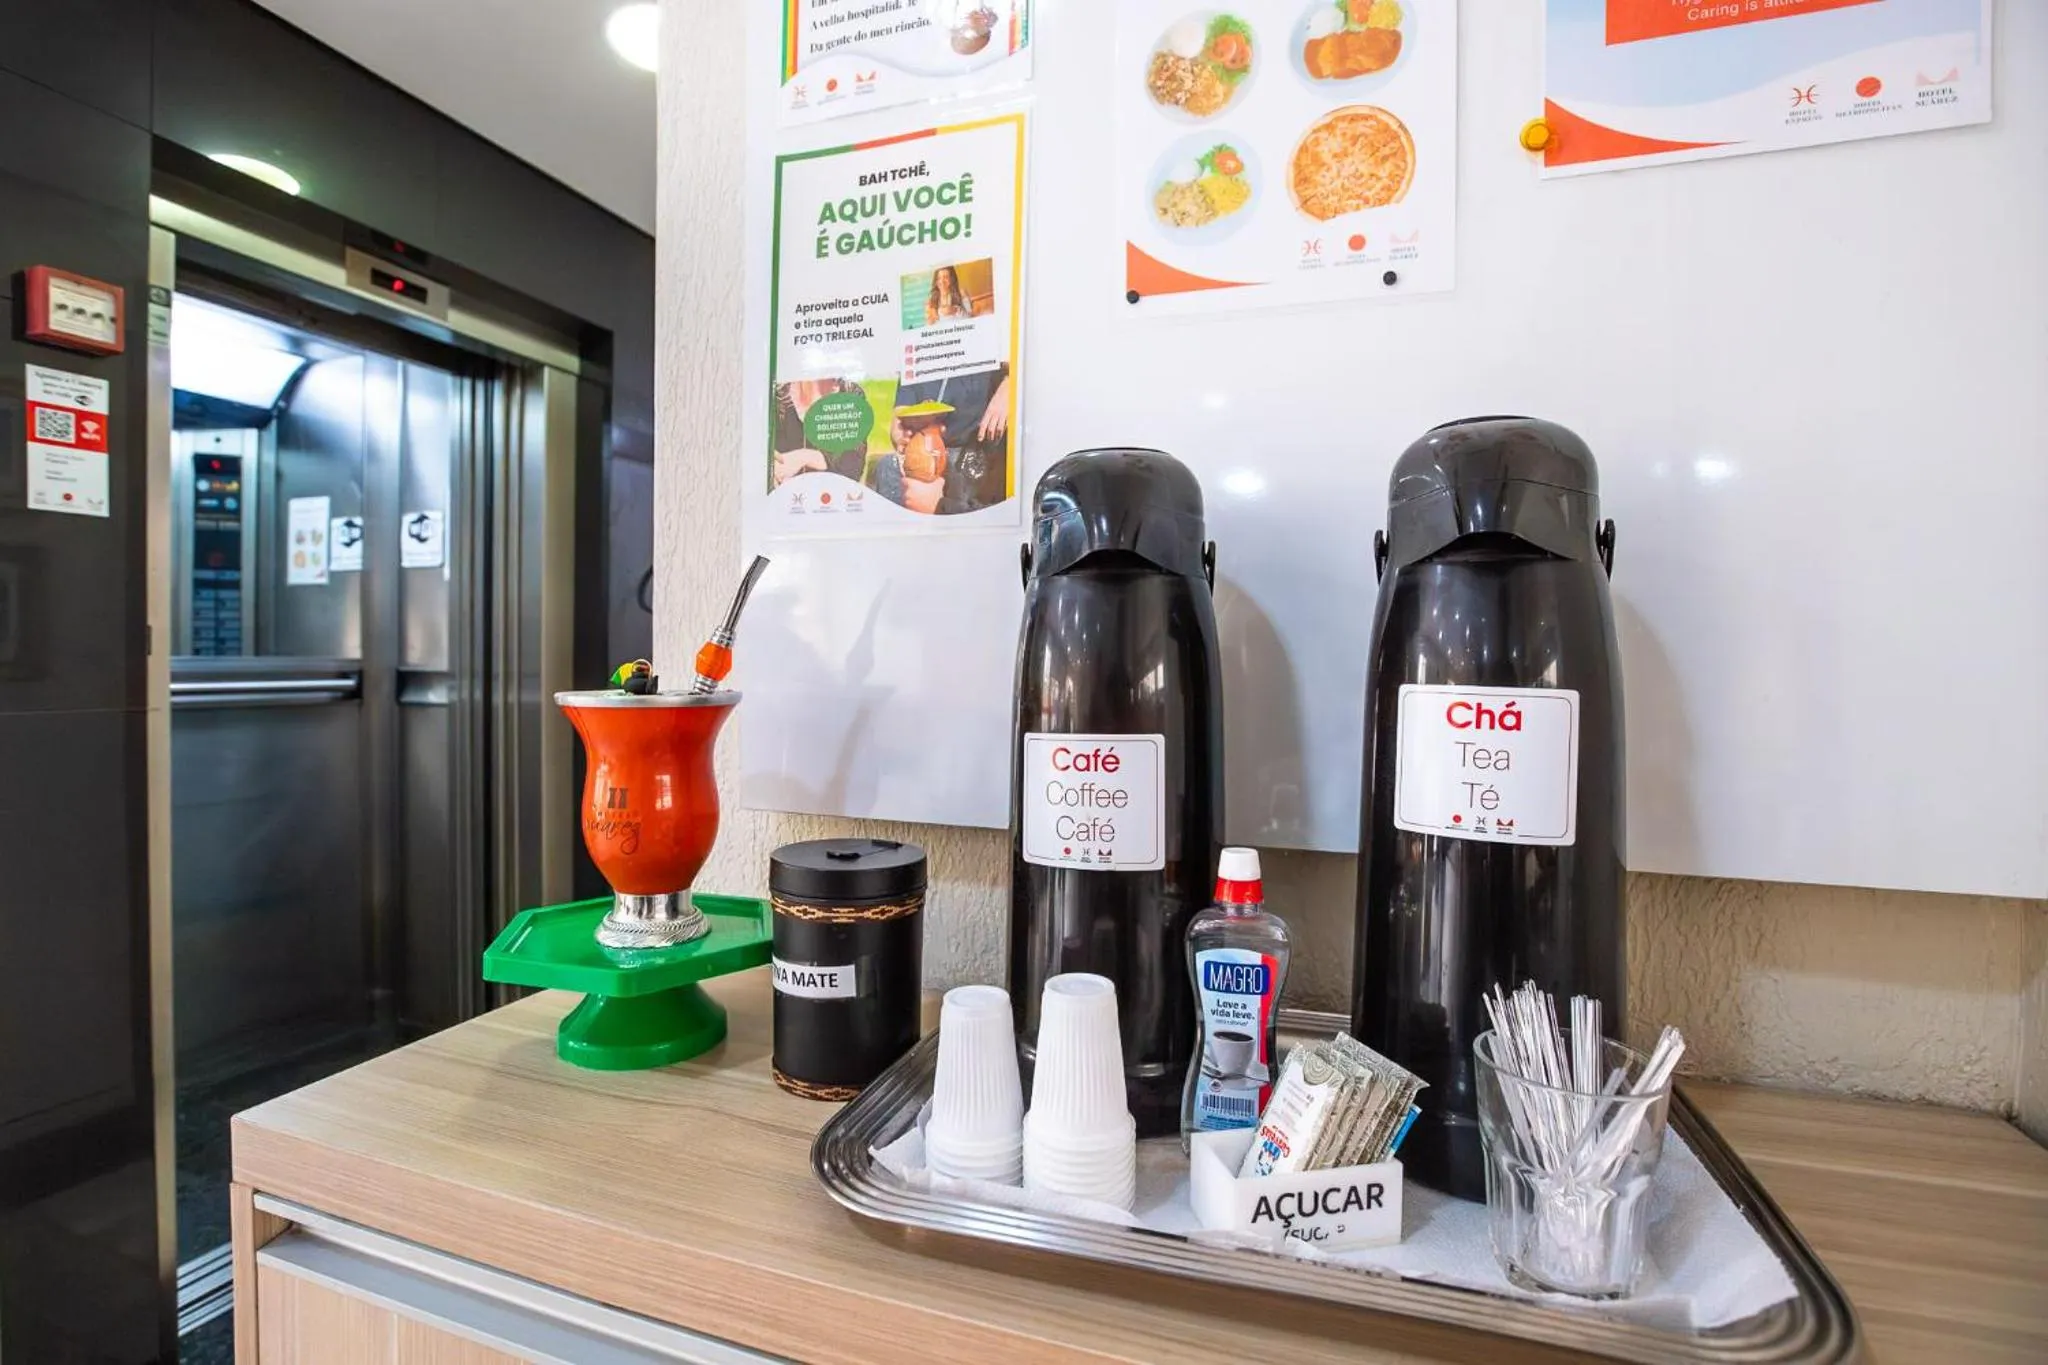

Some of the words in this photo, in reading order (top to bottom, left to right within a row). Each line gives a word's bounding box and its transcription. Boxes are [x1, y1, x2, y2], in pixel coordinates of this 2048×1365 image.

[1688, 4, 1739, 20] Caring
[1745, 0, 1759, 12] is
[810, 42, 824, 53] Da
[825, 34, 852, 52] gente
[854, 30, 868, 42] do
[870, 26, 893, 39] meu
[859, 170, 888, 187] BAH
[890, 160, 930, 182] TCHÊ,
[817, 192, 886, 226] AQUI
[893, 172, 974, 213] VOCÊ
[816, 228, 830, 259] É
[835, 213, 973, 256] GAÚCHO!
[795, 298, 849, 316] Aproveita
[851, 298, 860, 307] a
[861, 293, 890, 305] CUIA
[794, 320, 801, 330] e
[803, 317, 823, 329] tira
[824, 313, 864, 328] aquela
[793, 333, 823, 346] FOTO
[825, 327, 875, 343] TRILEGAL
[1446, 700, 1522, 731] Chá
[1052, 746, 1120, 773] Café
[1455, 741, 1510, 770] Tea
[1046, 780, 1128, 808] Coffee
[1461, 781, 1500, 810] Té
[1056, 815, 1115, 842] Café
[791, 970, 839, 988] MATE
[1209, 963, 1263, 993] MAGRO
[1210, 1008, 1231, 1018] vida
[1232, 1009, 1256, 1021] leve.
[1241, 1002, 1248, 1010] a
[1251, 1182, 1385, 1229] AÇUCAR
